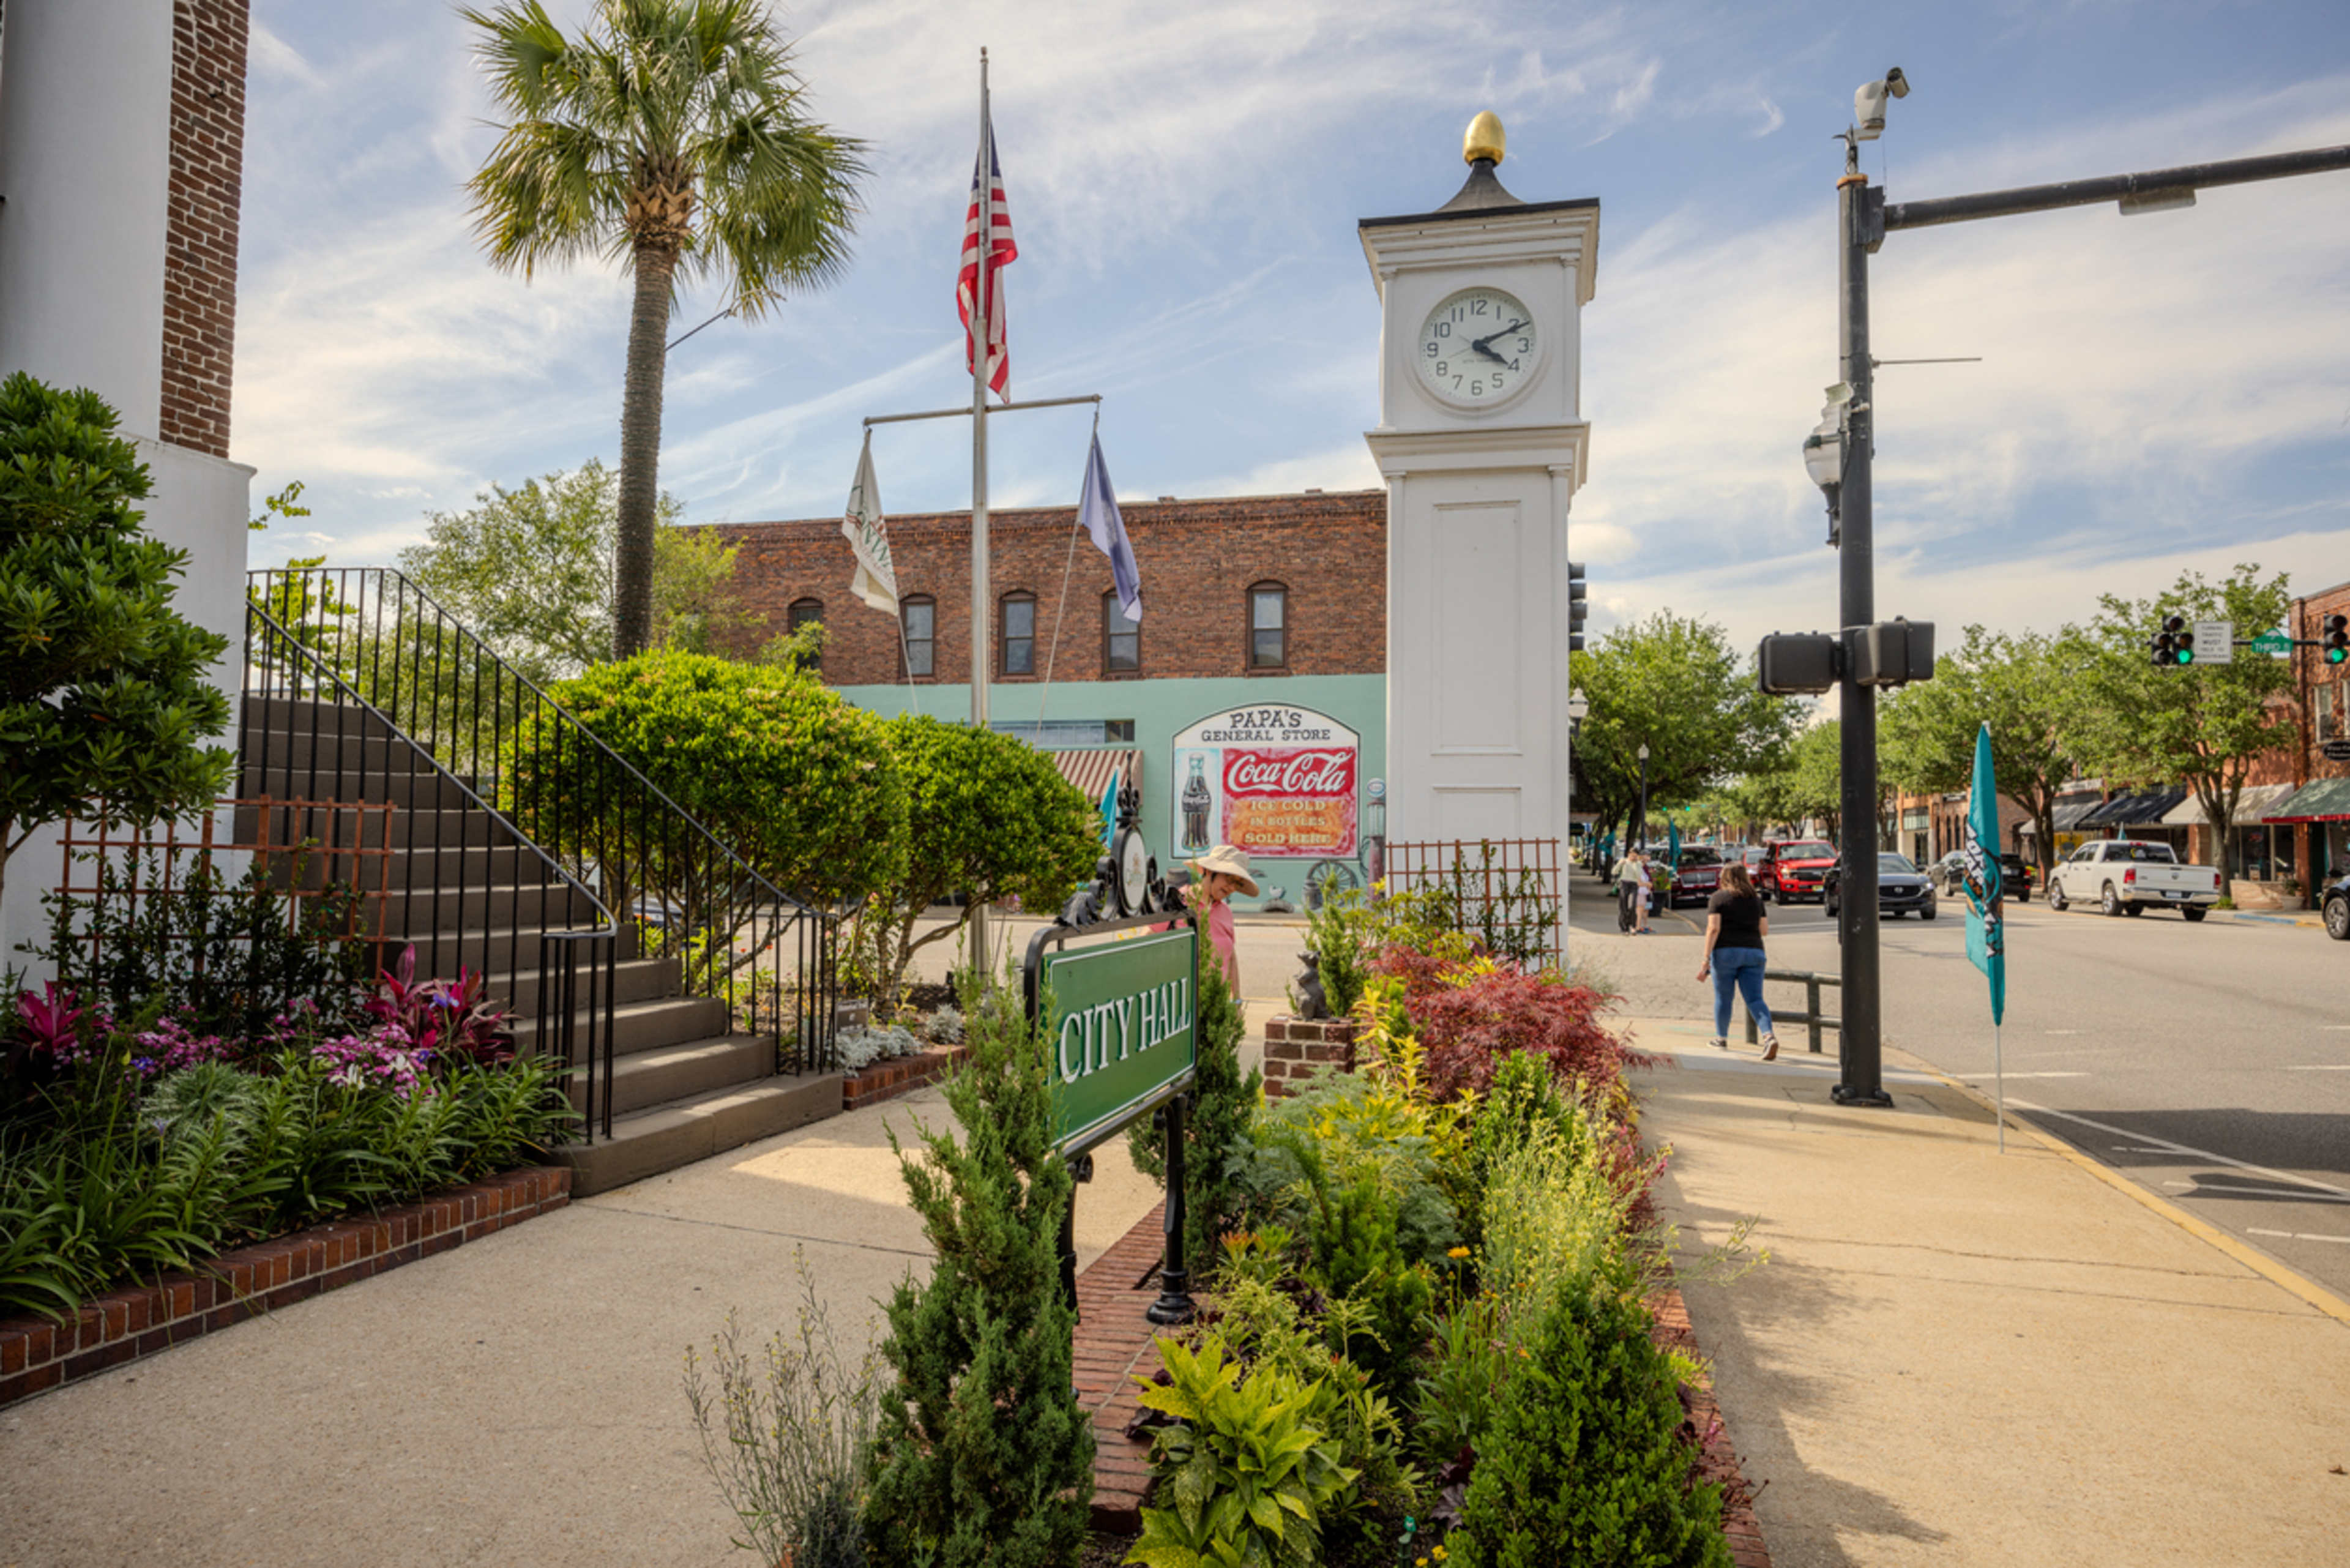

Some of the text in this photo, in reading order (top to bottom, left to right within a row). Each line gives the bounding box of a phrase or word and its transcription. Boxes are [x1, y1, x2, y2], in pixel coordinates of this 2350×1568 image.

[1452, 307, 1463, 323] 11
[1471, 299, 1488, 316] 12
[1496, 305, 1501, 320] 1
[1434, 322, 1451, 338] 10
[1427, 342, 1439, 357] 9
[1517, 337, 1529, 353] 3
[1436, 361, 1448, 377] 8
[1507, 357, 1520, 372] 4
[1452, 374, 1463, 390] 7
[1471, 380, 1483, 396] 6
[1491, 372, 1504, 388] 5
[1229, 709, 1302, 728] PAPA'S
[1201, 729, 1331, 742] GENERAL STORE
[1227, 751, 1355, 793] Coca-Cola
[1250, 800, 1326, 812] ICE COLD
[1250, 816, 1326, 826] IN BOTTLES
[1244, 832, 1331, 844] SOLD HERE
[1059, 977, 1191, 1085] CITY HALL
